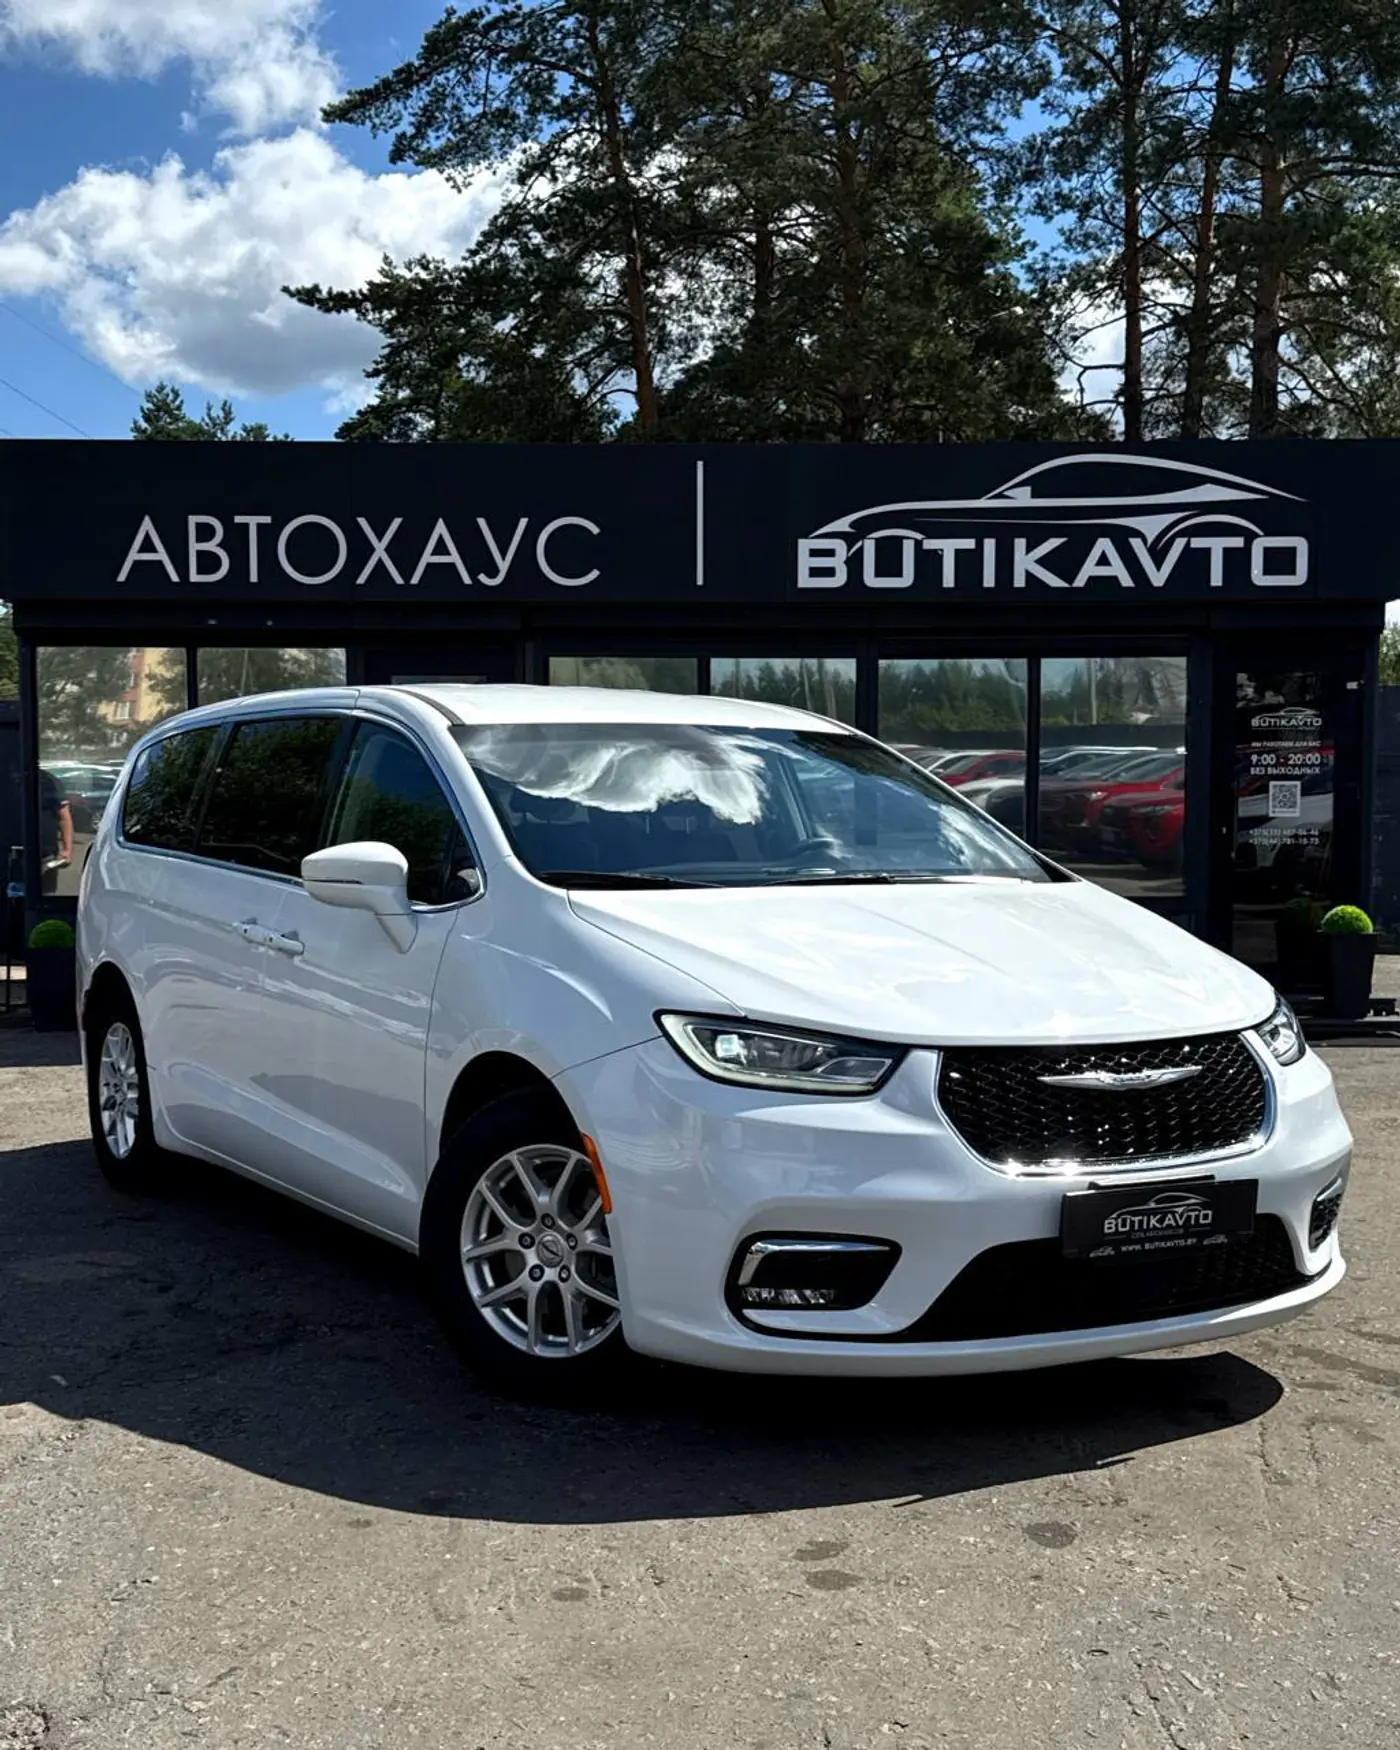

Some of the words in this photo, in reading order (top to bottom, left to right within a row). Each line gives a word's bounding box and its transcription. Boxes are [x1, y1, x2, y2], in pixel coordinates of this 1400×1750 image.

[116, 514, 601, 586] АВТОХАУС
[797, 535, 1309, 588] BUTIKAVTO
[1251, 717, 1322, 727] BUTIKAVTO
[1251, 753, 1276, 765] 9:00
[1288, 753, 1321, 765] 20:00
[1250, 767, 1265, 775] БЕЗ
[1267, 766, 1321, 775] ВЫХОДНЫХ
[1104, 1210, 1213, 1234] BUTIKAVTO
